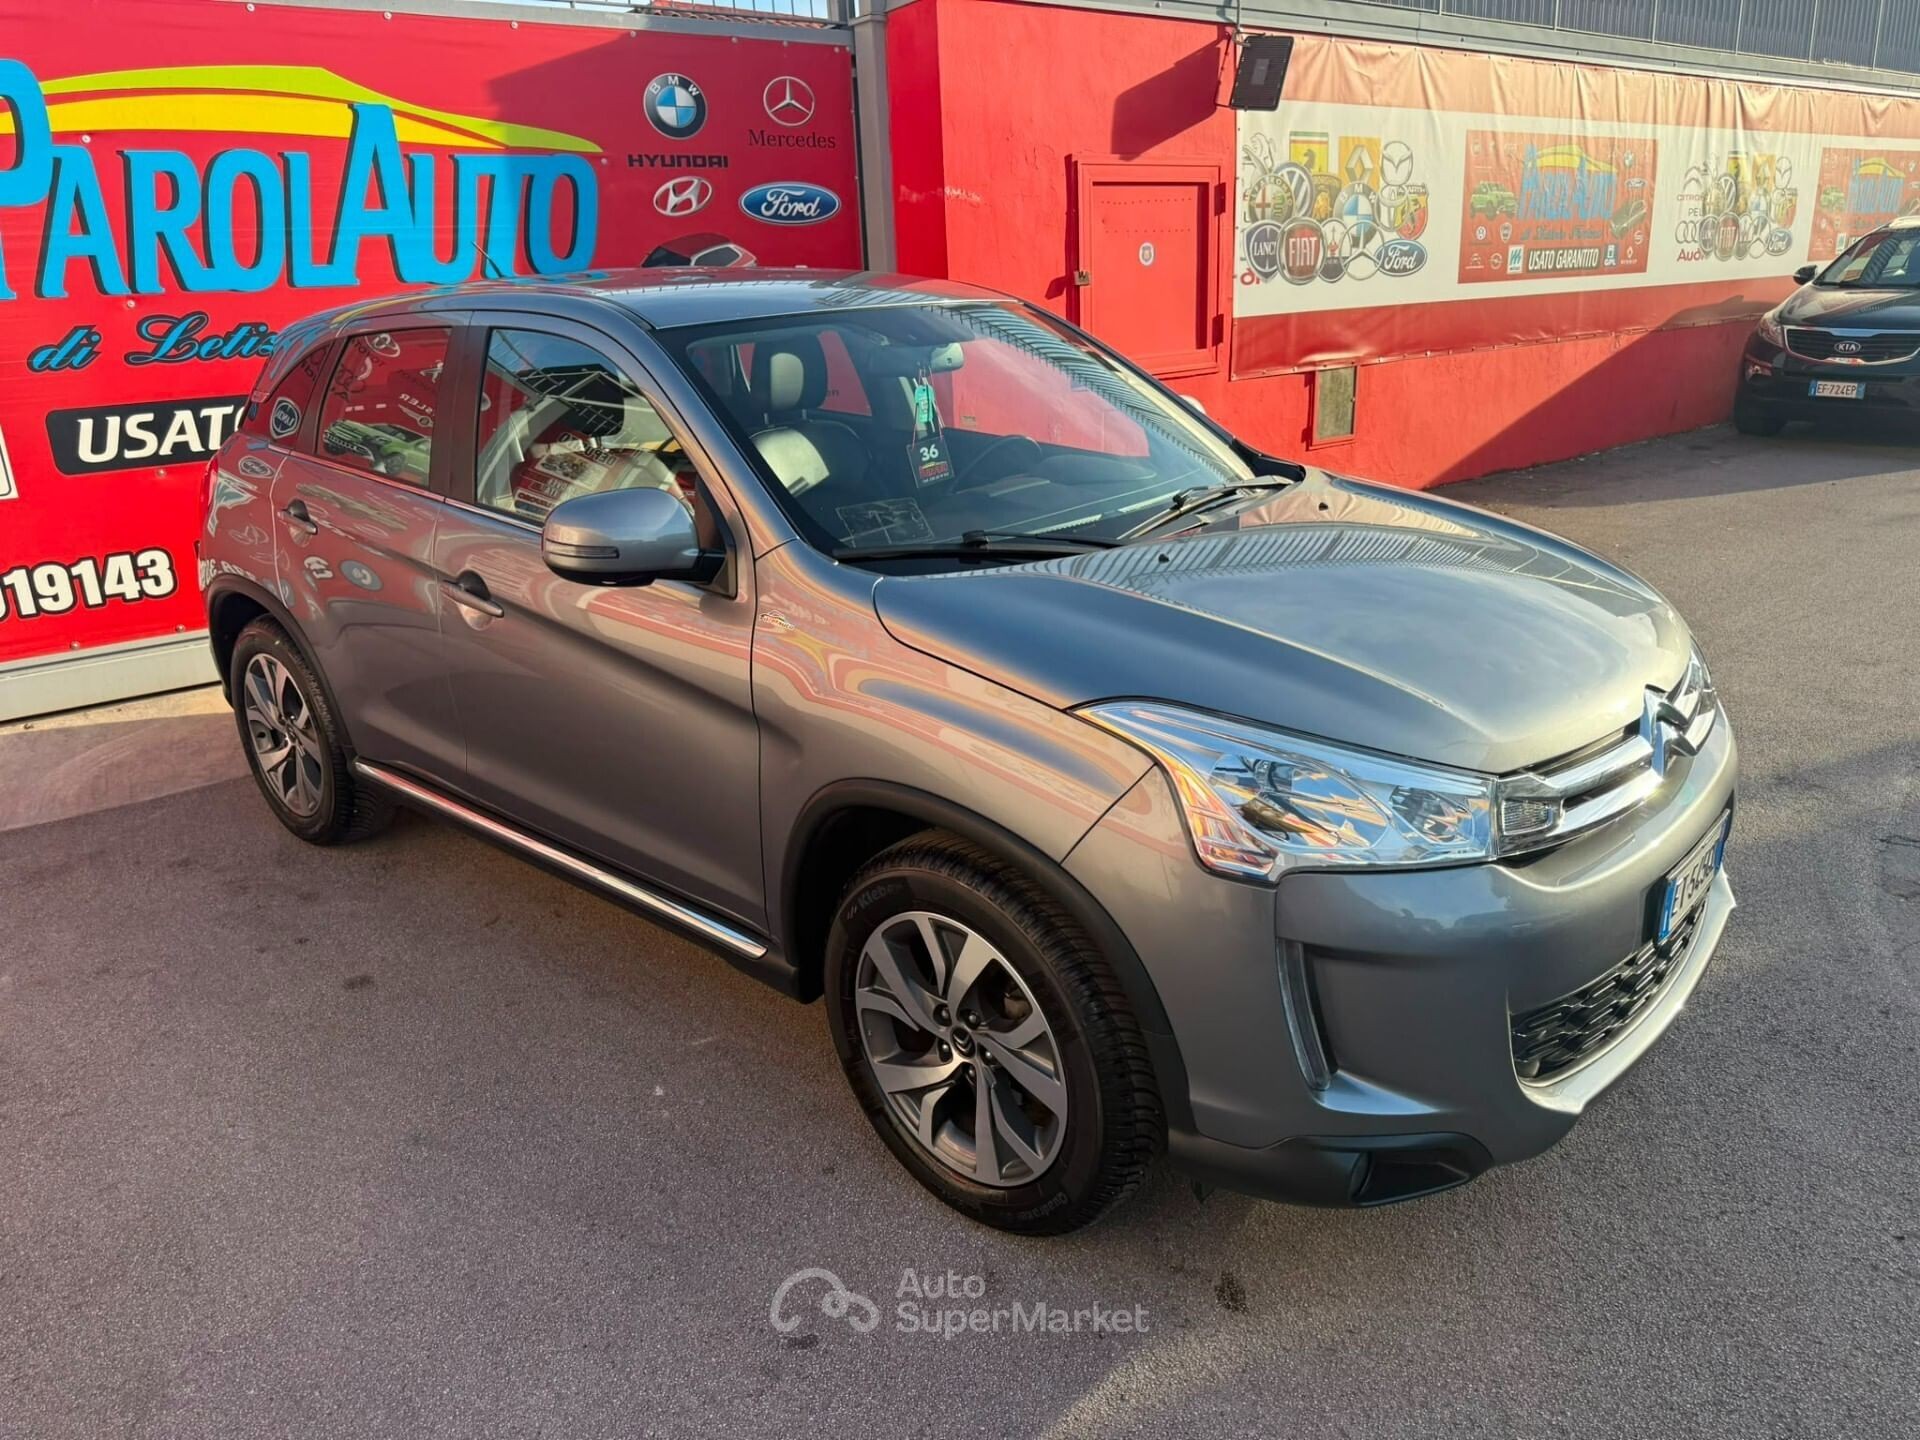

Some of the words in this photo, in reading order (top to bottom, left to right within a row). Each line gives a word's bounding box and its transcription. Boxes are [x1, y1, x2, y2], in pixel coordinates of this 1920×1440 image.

[748, 129, 836, 149] Mercedes
[628, 154, 728, 168] HYUNDAI
[760, 188, 820, 217] Ford
[1289, 237, 1318, 267] FIAT
[1384, 244, 1418, 270] Ford
[1528, 250, 1553, 271] USATO
[1555, 248, 1599, 269] GARANTITO
[27, 323, 102, 372] di
[1838, 343, 1856, 352] KIA
[920, 444, 939, 461] 36
[0, 549, 176, 619] 19143
